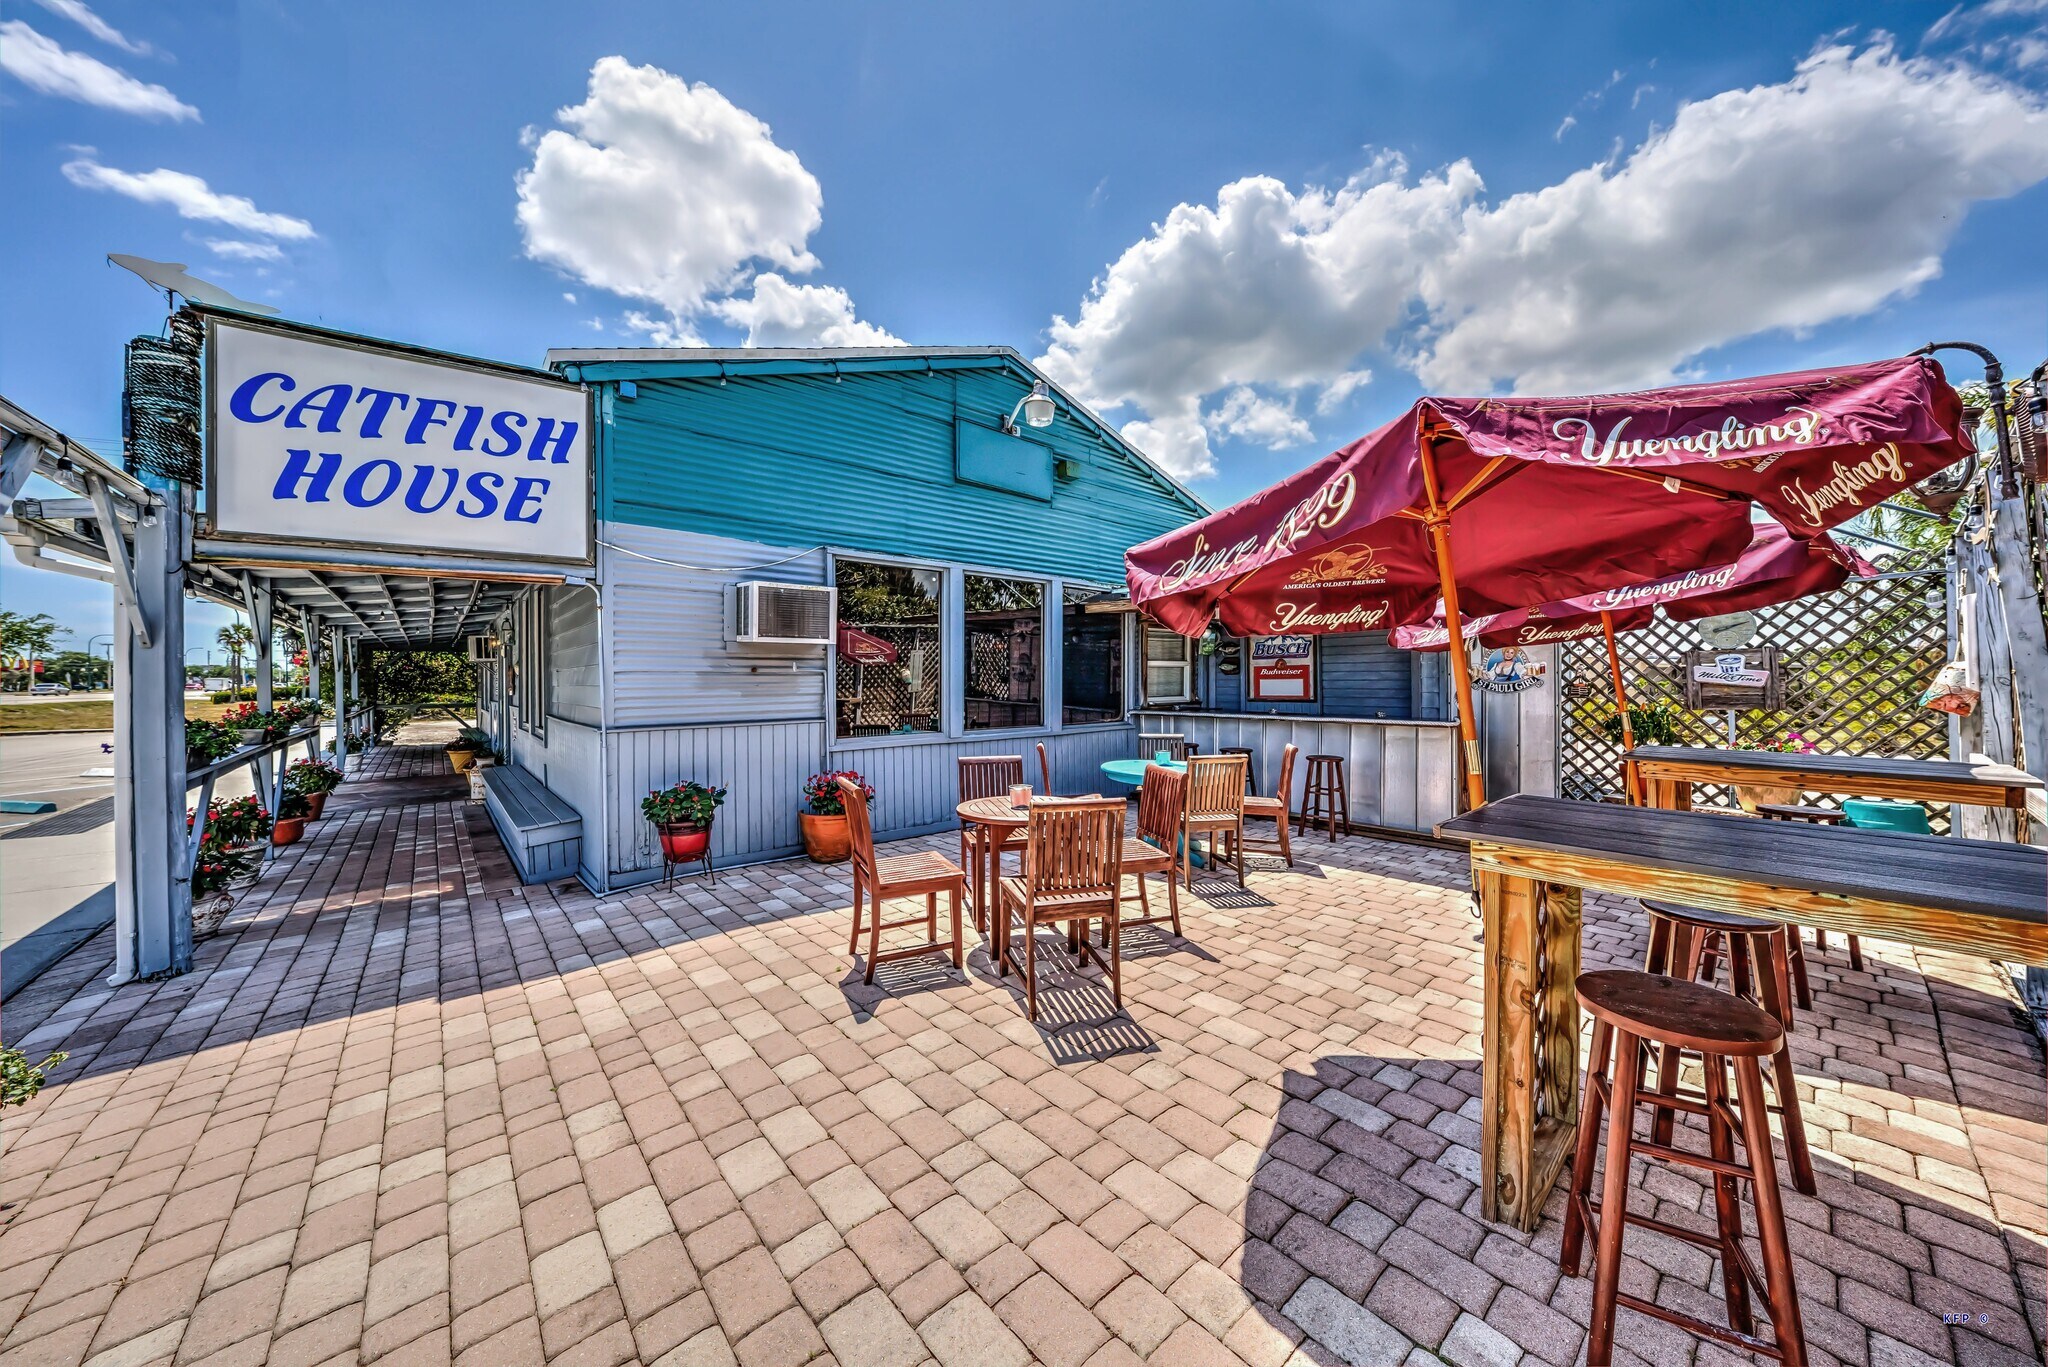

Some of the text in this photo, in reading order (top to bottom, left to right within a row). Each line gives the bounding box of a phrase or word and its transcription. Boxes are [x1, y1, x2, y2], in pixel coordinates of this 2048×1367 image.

[229, 372, 579, 464] CATFISH
[1552, 406, 1821, 465] Yuengling
[272, 448, 551, 524] HOUSE
[1780, 442, 1906, 527] Yuengling
[1159, 471, 1357, 591] Since 1829
[1283, 582, 1321, 590] AMERICA'S
[1322, 580, 1351, 588] OLDEST
[1593, 563, 1738, 609] Yuengling
[1269, 600, 1389, 632] Yuengling
[1518, 622, 1604, 644] Yuengling
[1254, 640, 1312, 657] BUSCH
[1488, 682, 1514, 693] PAULI
[1514, 677, 1538, 689] GIRL
